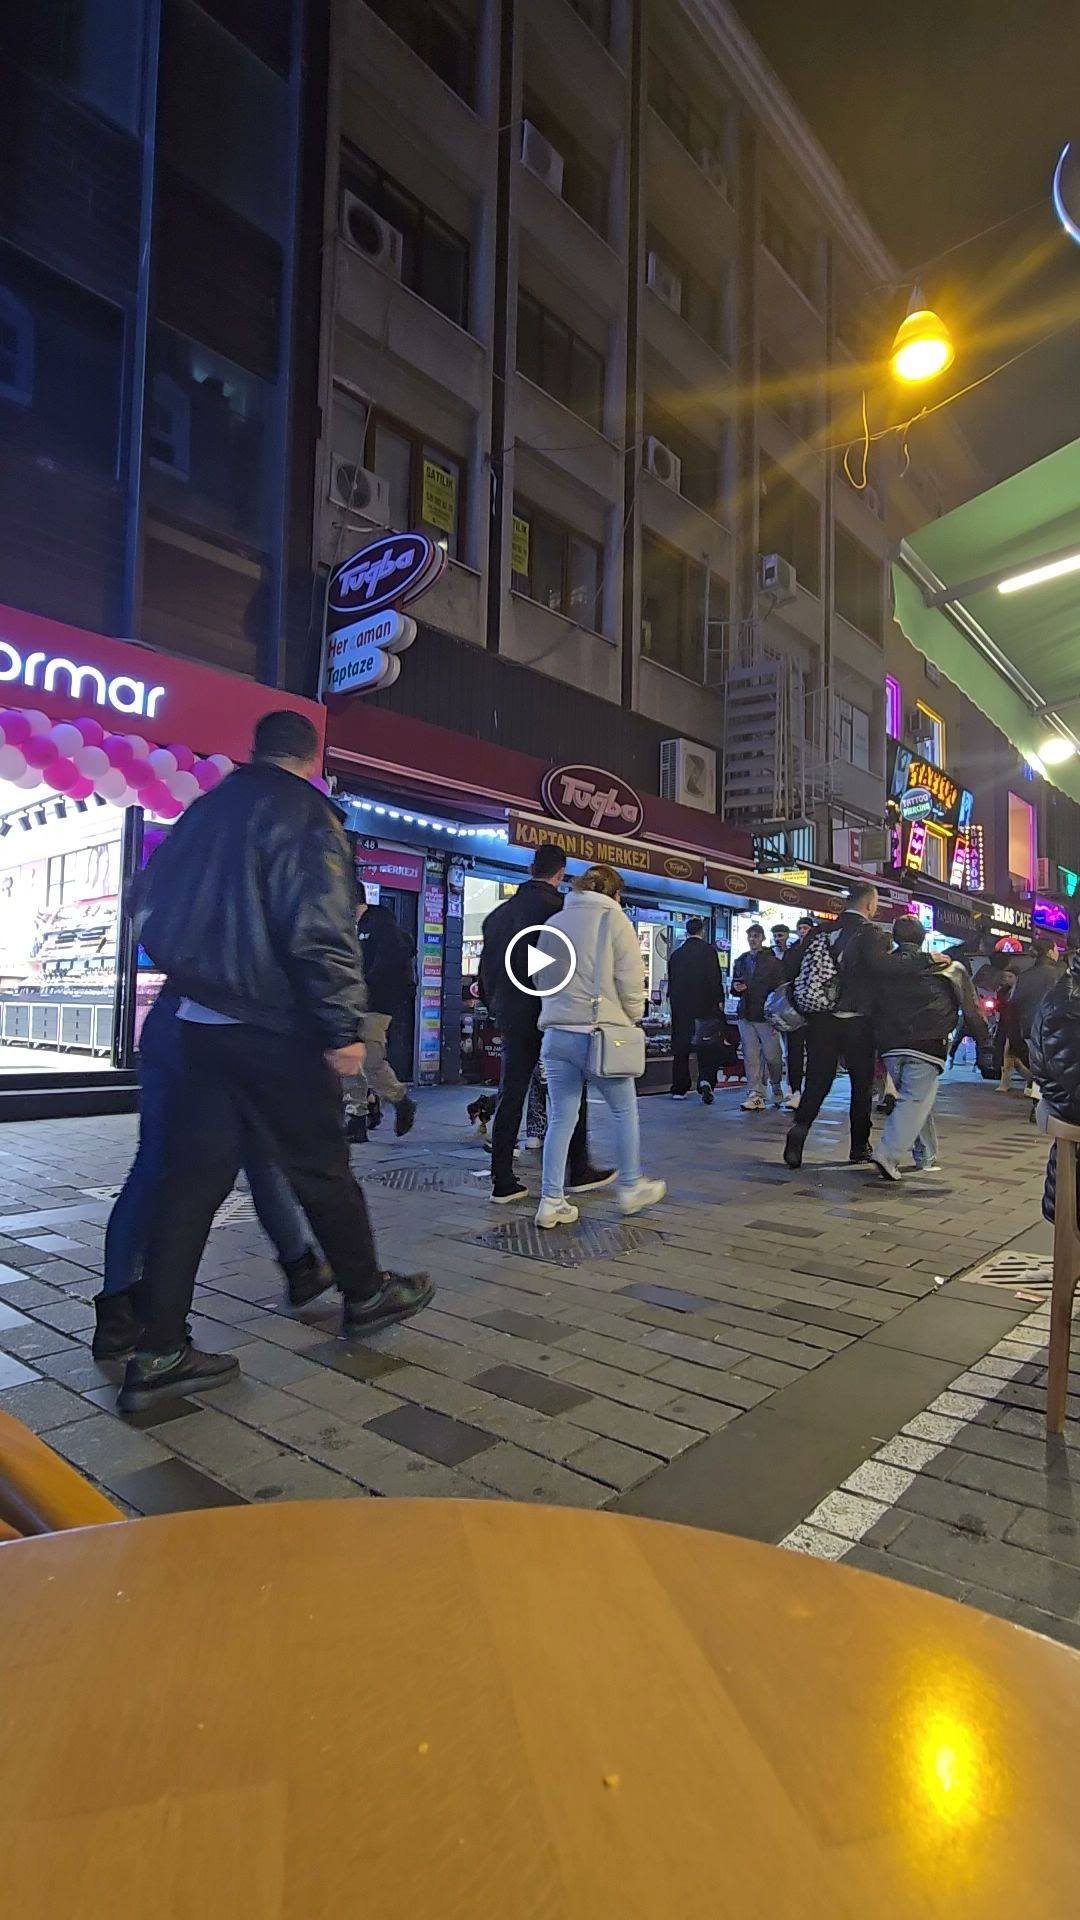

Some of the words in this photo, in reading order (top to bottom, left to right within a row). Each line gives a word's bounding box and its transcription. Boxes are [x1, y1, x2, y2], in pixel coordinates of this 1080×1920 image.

[328, 637, 348, 659] Her
[328, 656, 374, 686] Taptaze
[903, 794, 929, 807] TATTOO
[363, 839, 375, 850] 48
[515, 823, 576, 853] KAPTAN
[580, 835, 594, 859] İŞ
[597, 843, 650, 870] MERKEZİ
[1015, 910, 1031, 930] CAFE
